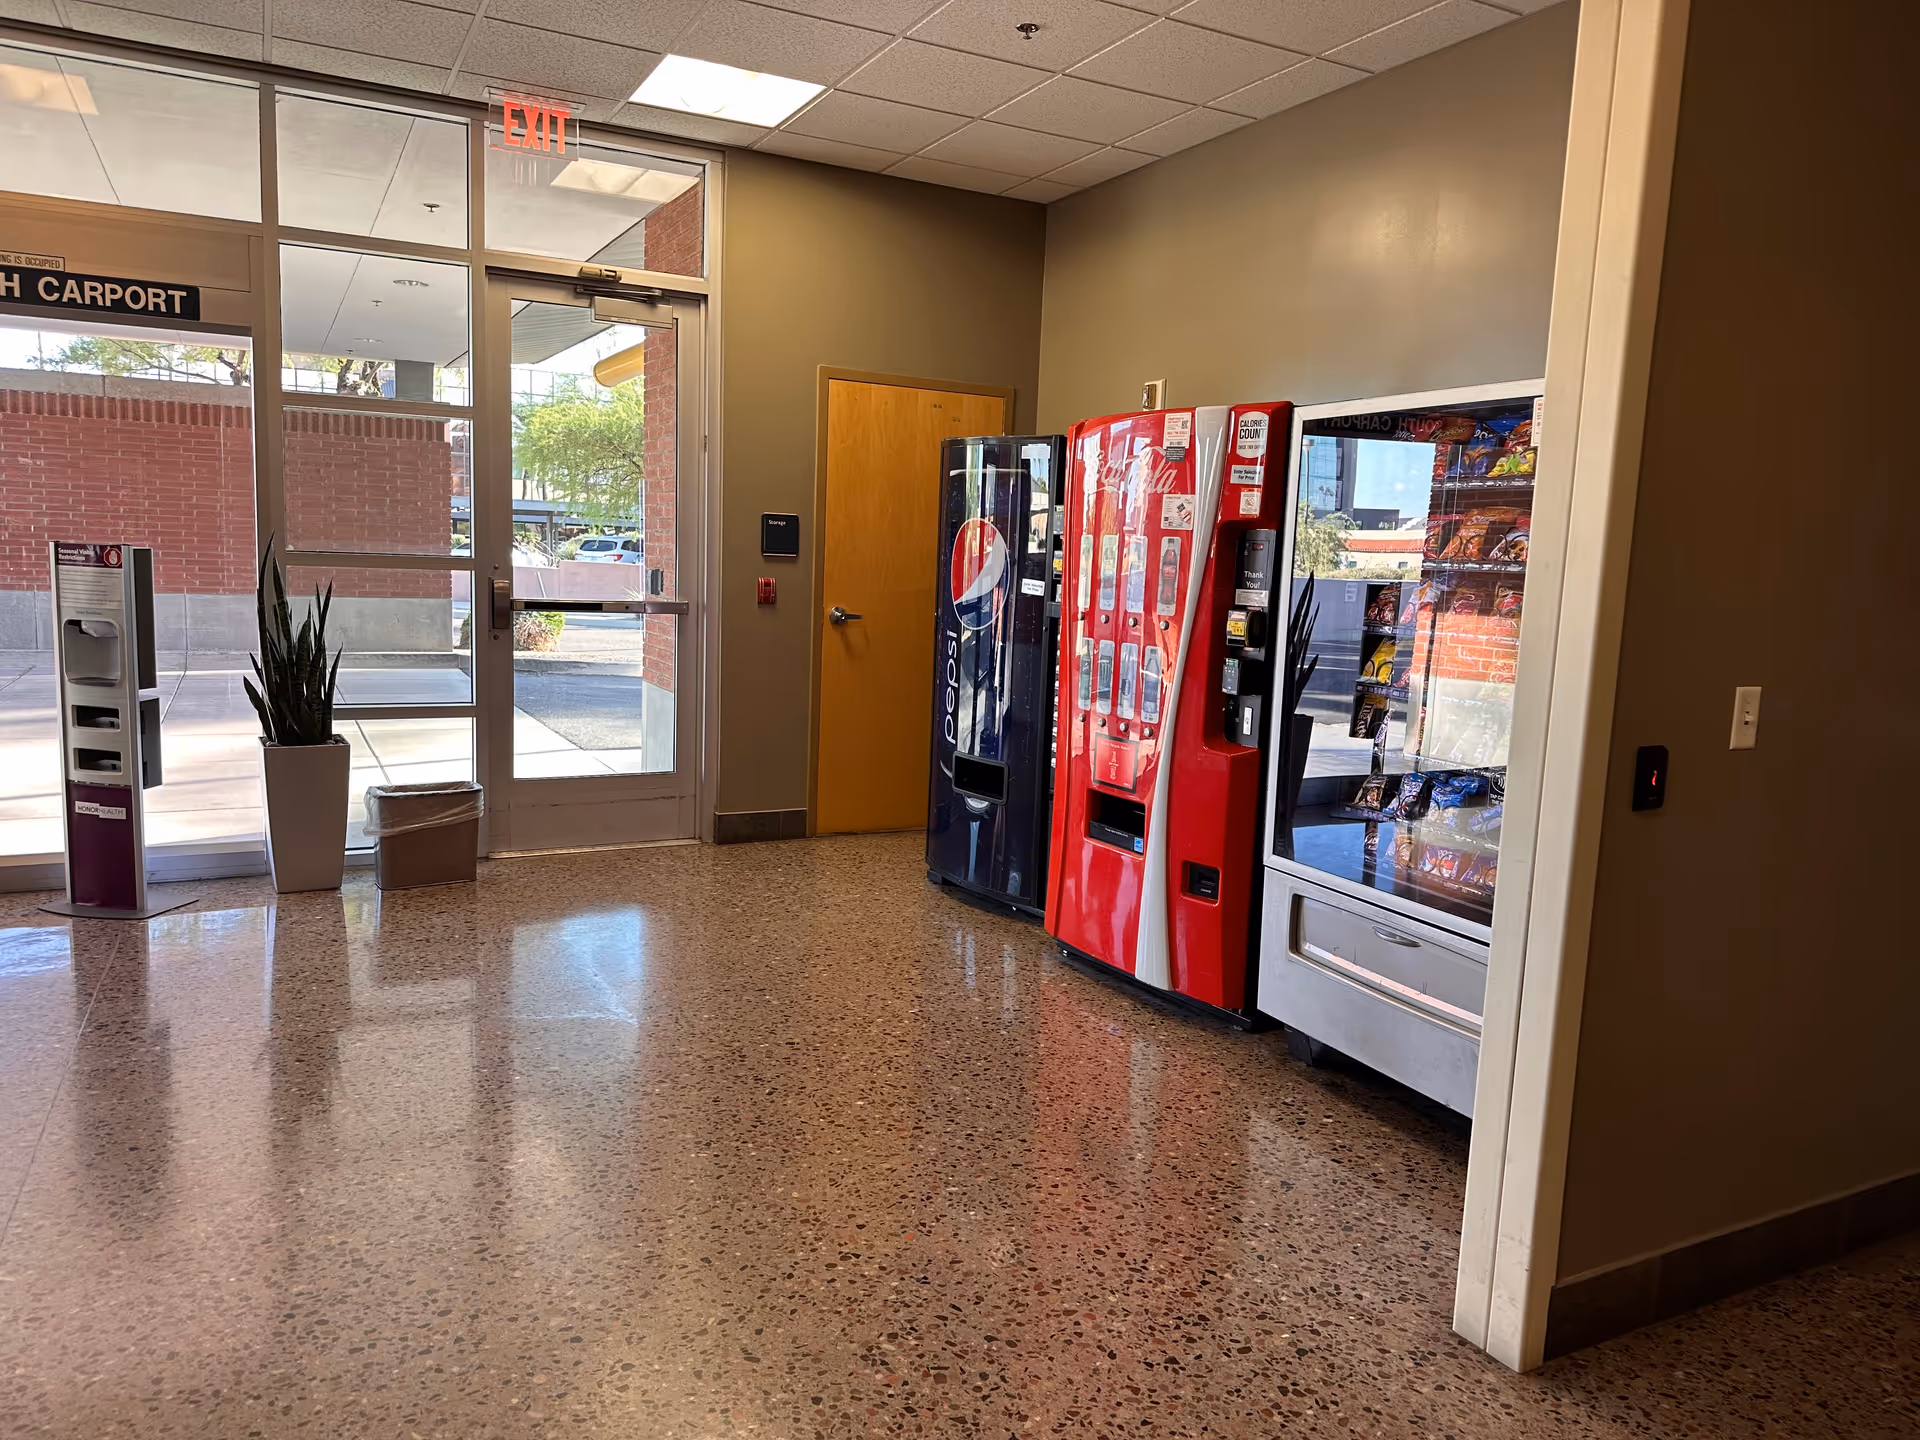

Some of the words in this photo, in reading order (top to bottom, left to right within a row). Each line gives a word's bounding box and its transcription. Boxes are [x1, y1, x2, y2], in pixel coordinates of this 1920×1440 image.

[503, 99, 571, 154] EXIT
[14, 254, 22, 265] IS
[25, 256, 61, 269] OCCUPIED
[0, 272, 21, 298] H
[37, 276, 187, 314] CARPORT
[1240, 419, 1267, 428] CALORIES
[1239, 428, 1267, 440] COUNT
[768, 519, 786, 527] Storage
[1244, 571, 1264, 579] Thank
[1246, 581, 1261, 589] You!
[944, 630, 958, 744] pepsi
[77, 805, 123, 815] HONORHEALTH
